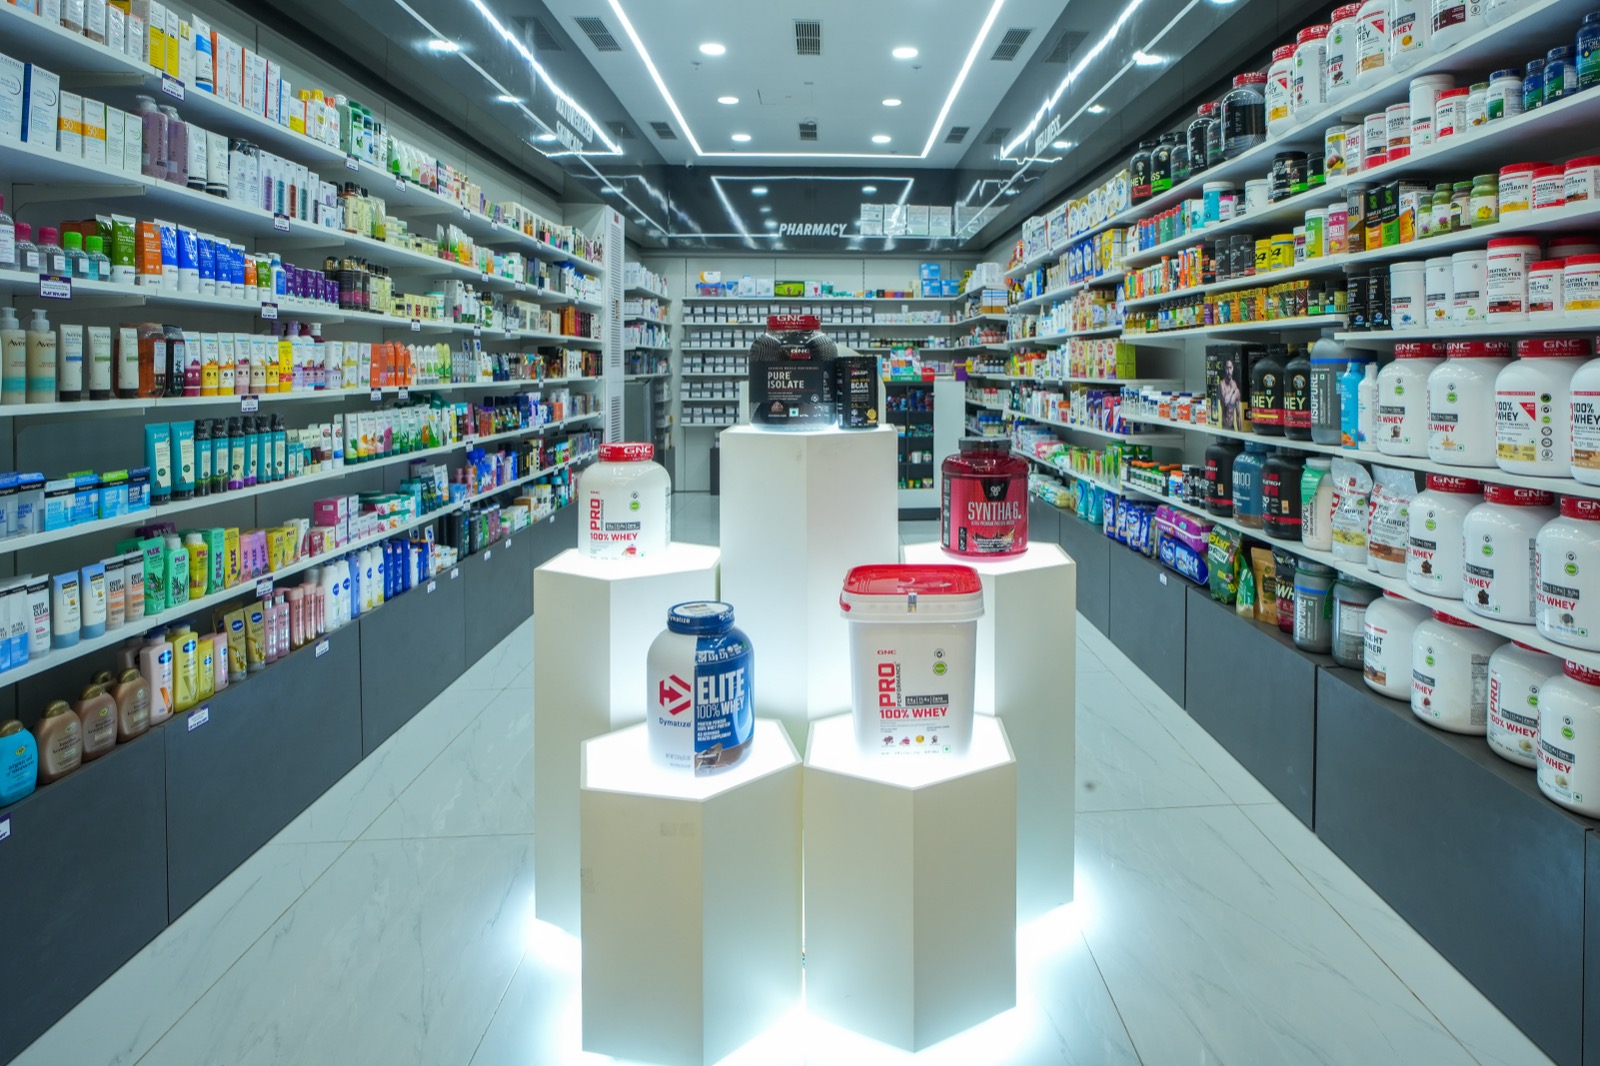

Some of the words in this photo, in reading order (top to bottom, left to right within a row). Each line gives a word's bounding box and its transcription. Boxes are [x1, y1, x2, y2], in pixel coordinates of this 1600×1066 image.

[1346, 2, 1364, 10] GN
[1357, 30, 1371, 43] HEY
[1327, 63, 1342, 74] HEY
[1035, 114, 1060, 154] WELLNESS
[1131, 176, 1145, 186] HEY
[779, 223, 847, 236] PHARMACY
[1543, 339, 1580, 348] GNC
[768, 371, 790, 380] PURE
[768, 380, 804, 389] ISOLATE
[1252, 395, 1275, 408] HEY
[1284, 397, 1306, 410] HEY
[1497, 402, 1513, 411] 00%
[1574, 403, 1595, 414] 100%
[1498, 412, 1518, 421] WHEY
[624, 445, 651, 454] GNC
[1433, 476, 1466, 485] GNC
[1484, 486, 1499, 494] NC
[1514, 488, 1550, 497] GNC
[1578, 501, 1600, 510] GN
[590, 499, 601, 531] PRO
[612, 532, 638, 540] WHEY
[1413, 549, 1433, 559] WHEY
[132, 573, 142, 581] DEEP
[1468, 577, 1490, 589] WHEY
[1276, 585, 1294, 600] WH
[33, 602, 44, 610] DEEP
[1547, 597, 1576, 611] WHEY
[34, 607, 48, 617] CLEAN
[670, 615, 690, 624] ymatize
[697, 668, 744, 705] ELITE
[878, 663, 896, 707] PRO
[1414, 683, 1433, 696] WHEY
[1490, 678, 1499, 713] PRO
[697, 704, 720, 719] 100%
[721, 696, 744, 715] WHEY
[880, 709, 909, 719] 100%
[912, 707, 947, 718] WHEY
[659, 717, 691, 728] Dymatize
[1506, 723, 1536, 738] WHEY
[1545, 755, 1571, 774] WHEY
